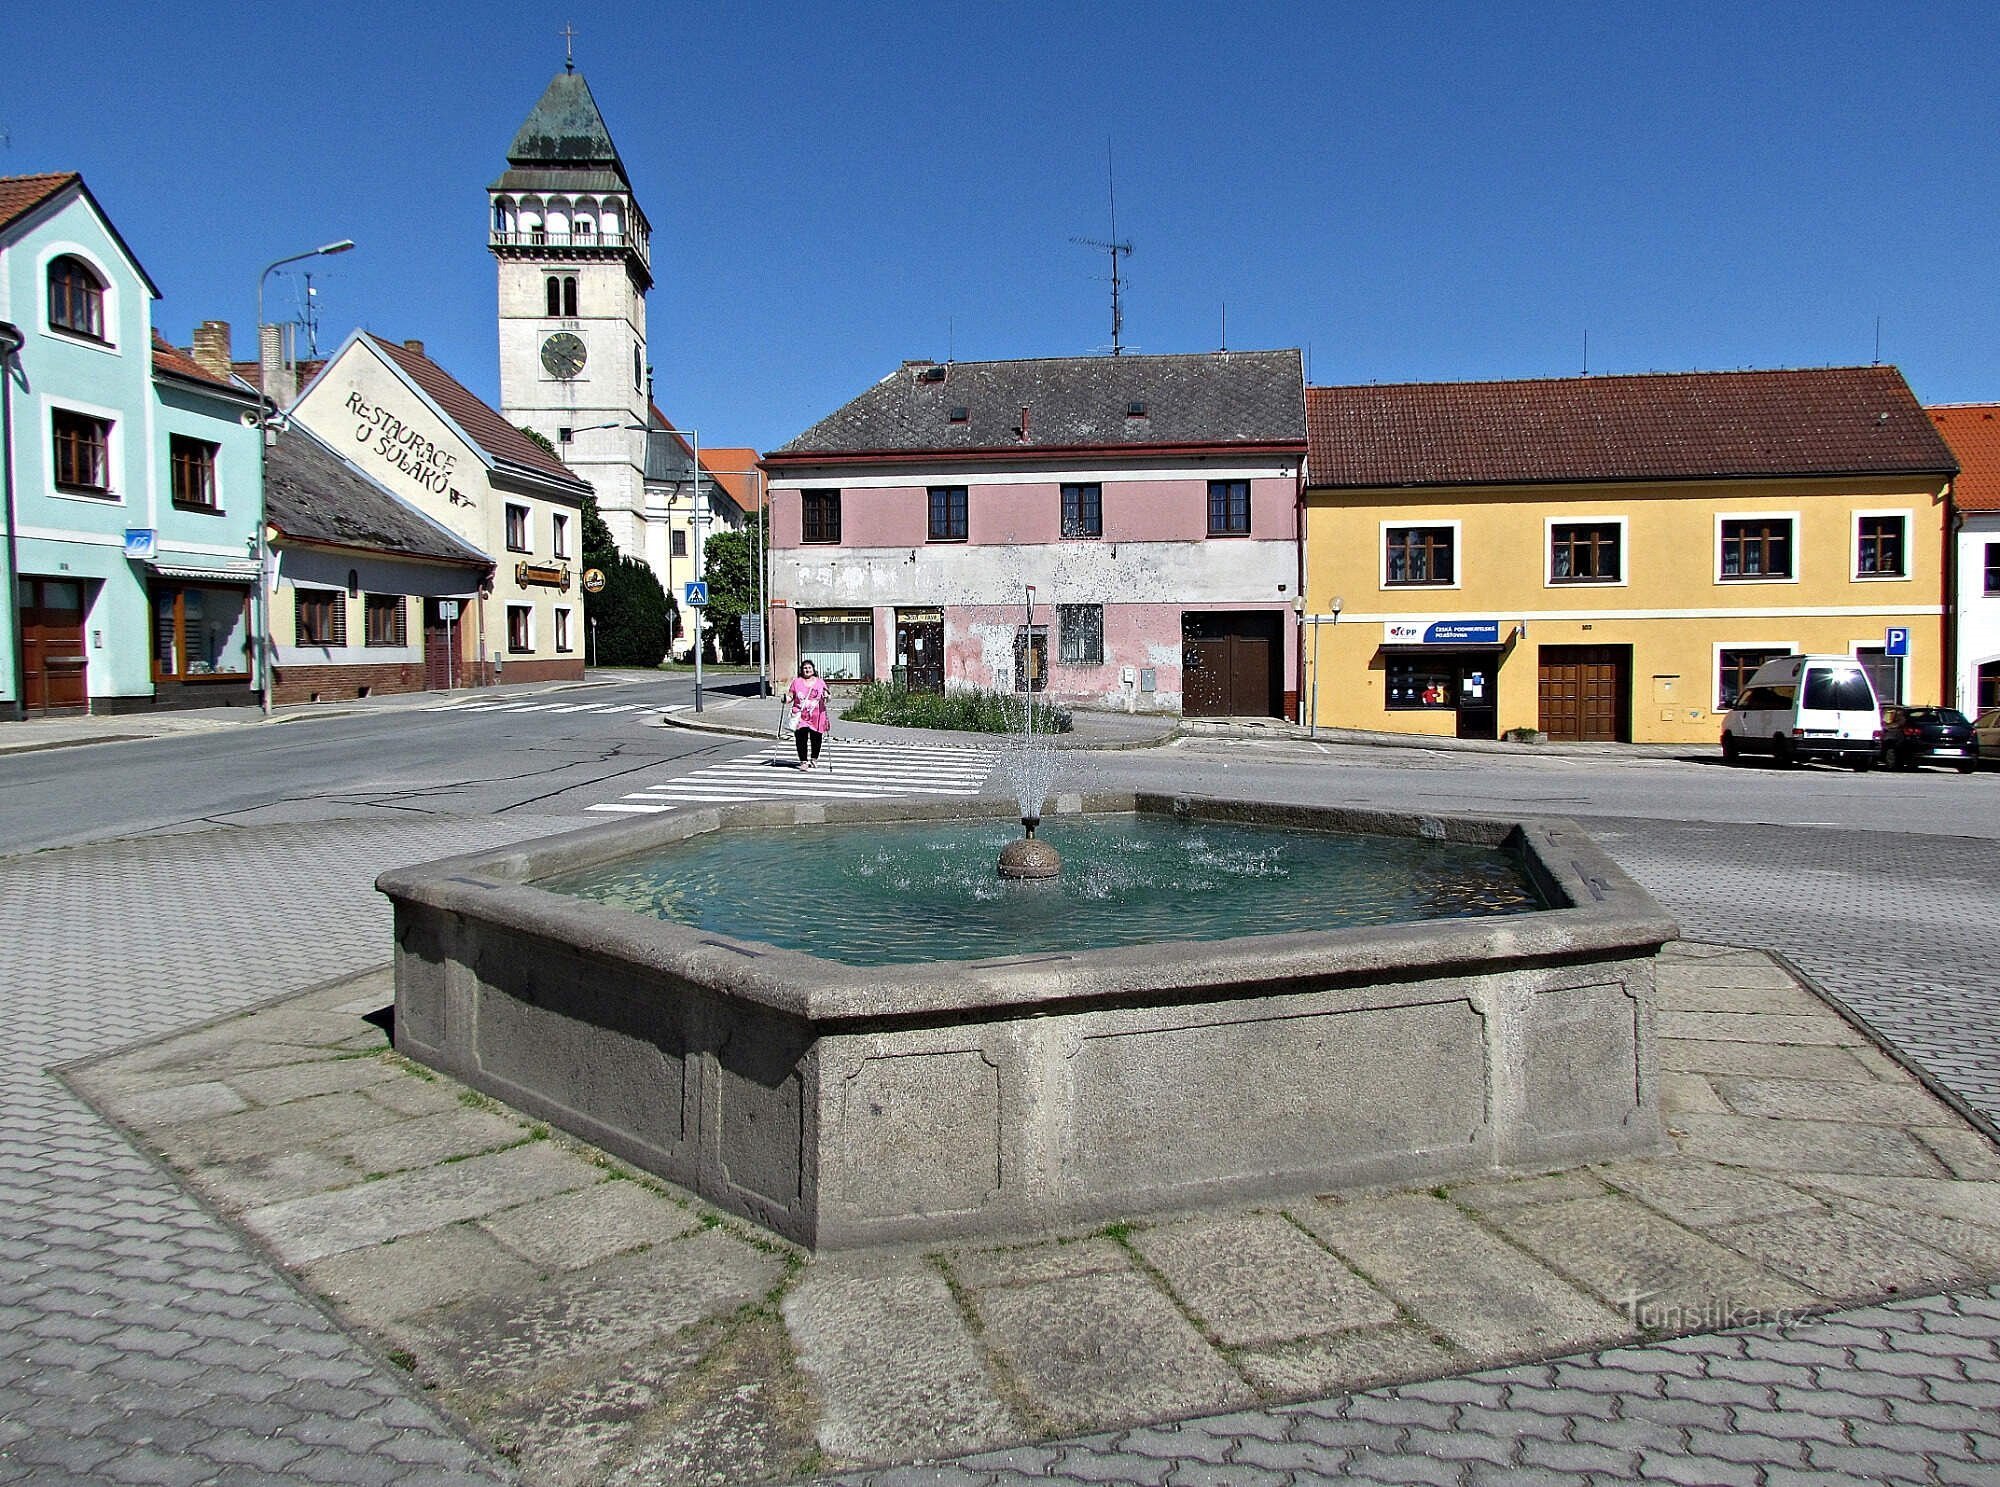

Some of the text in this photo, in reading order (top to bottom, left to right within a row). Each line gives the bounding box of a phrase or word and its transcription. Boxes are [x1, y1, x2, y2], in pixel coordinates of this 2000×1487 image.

[345, 391, 457, 475] RESTAURACE
[355, 424, 373, 442] U
[1890, 630, 1904, 648] P
